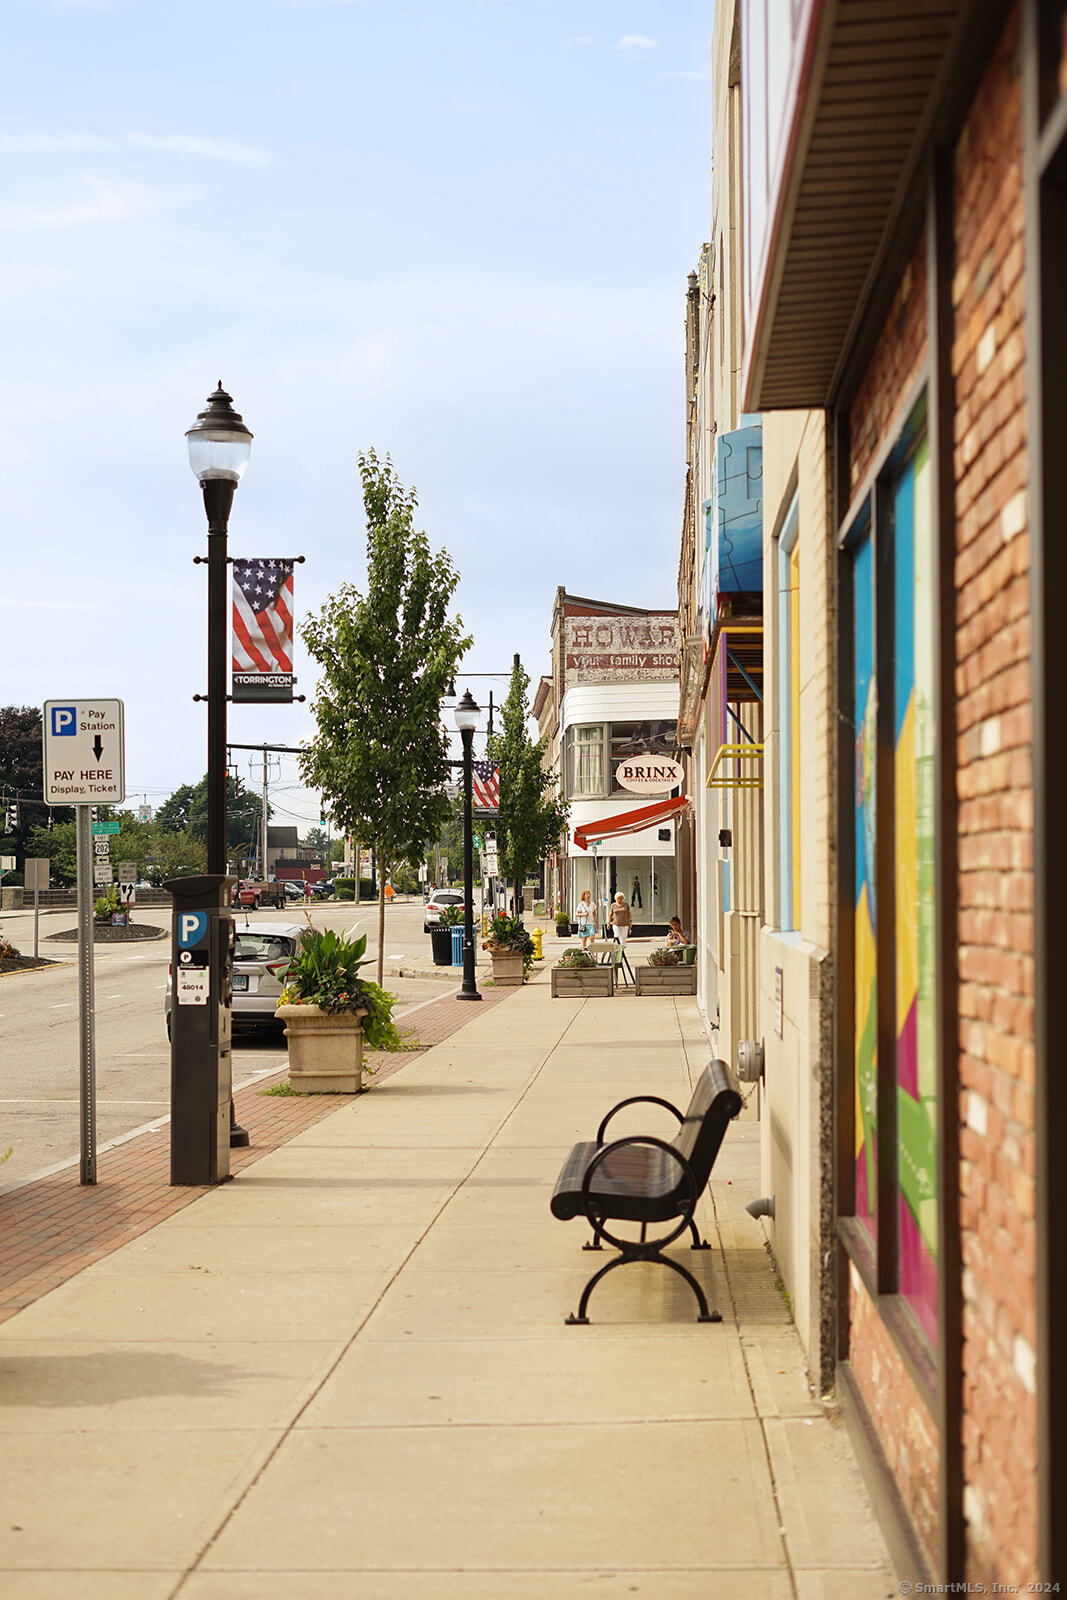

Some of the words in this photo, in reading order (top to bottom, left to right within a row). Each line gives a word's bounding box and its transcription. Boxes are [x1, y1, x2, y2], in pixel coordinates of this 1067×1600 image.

[573, 656, 602, 667] your
[609, 655, 647, 667] family
[238, 676, 292, 684] TORRINGTON
[88, 710, 106, 719] Pay
[55, 710, 73, 733] P
[80, 722, 116, 731] Station
[54, 771, 75, 781] PAY
[80, 770, 113, 780] HERE
[623, 766, 678, 778] BRINX
[88, 784, 117, 792] Ticket
[96, 845, 109, 853] 202
[181, 914, 200, 942] P
